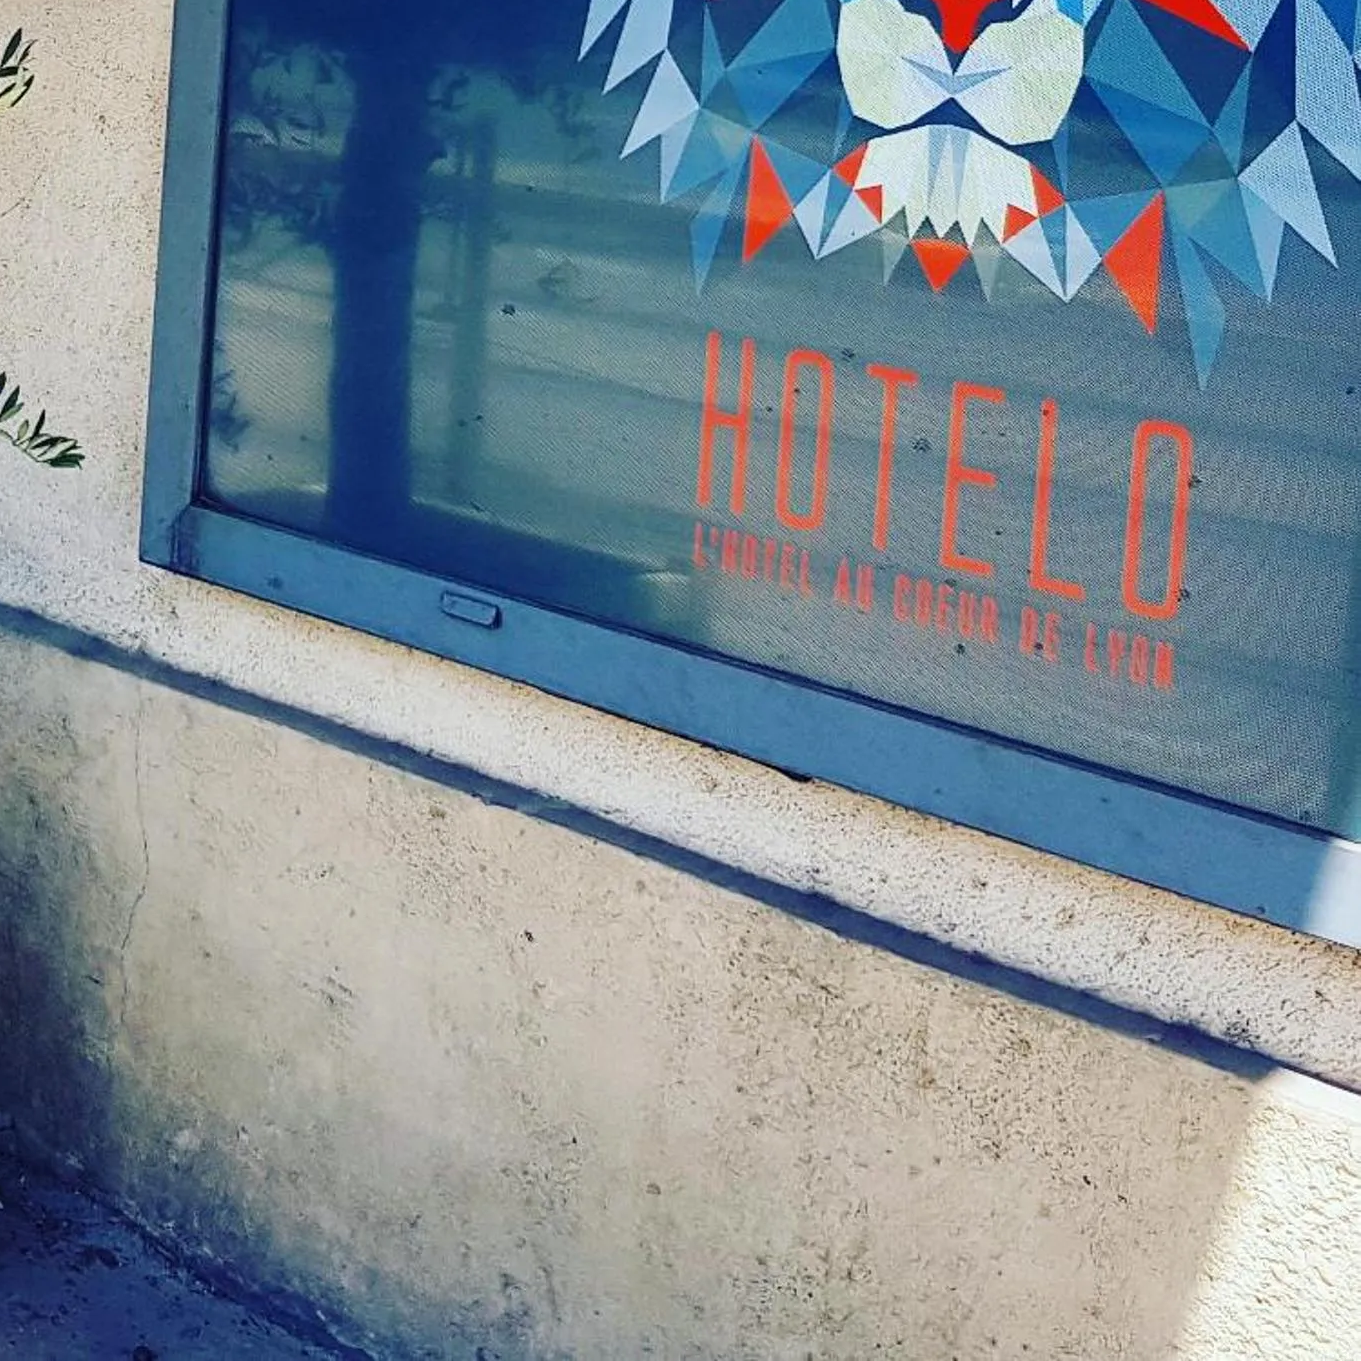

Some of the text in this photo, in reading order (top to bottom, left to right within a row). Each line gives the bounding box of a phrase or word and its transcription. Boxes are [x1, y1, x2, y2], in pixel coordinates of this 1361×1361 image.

[696, 330, 1194, 622] HOTELO
[833, 556, 875, 614] AU
[1019, 605, 1060, 663] DE
[1085, 621, 1174, 691] LYON
